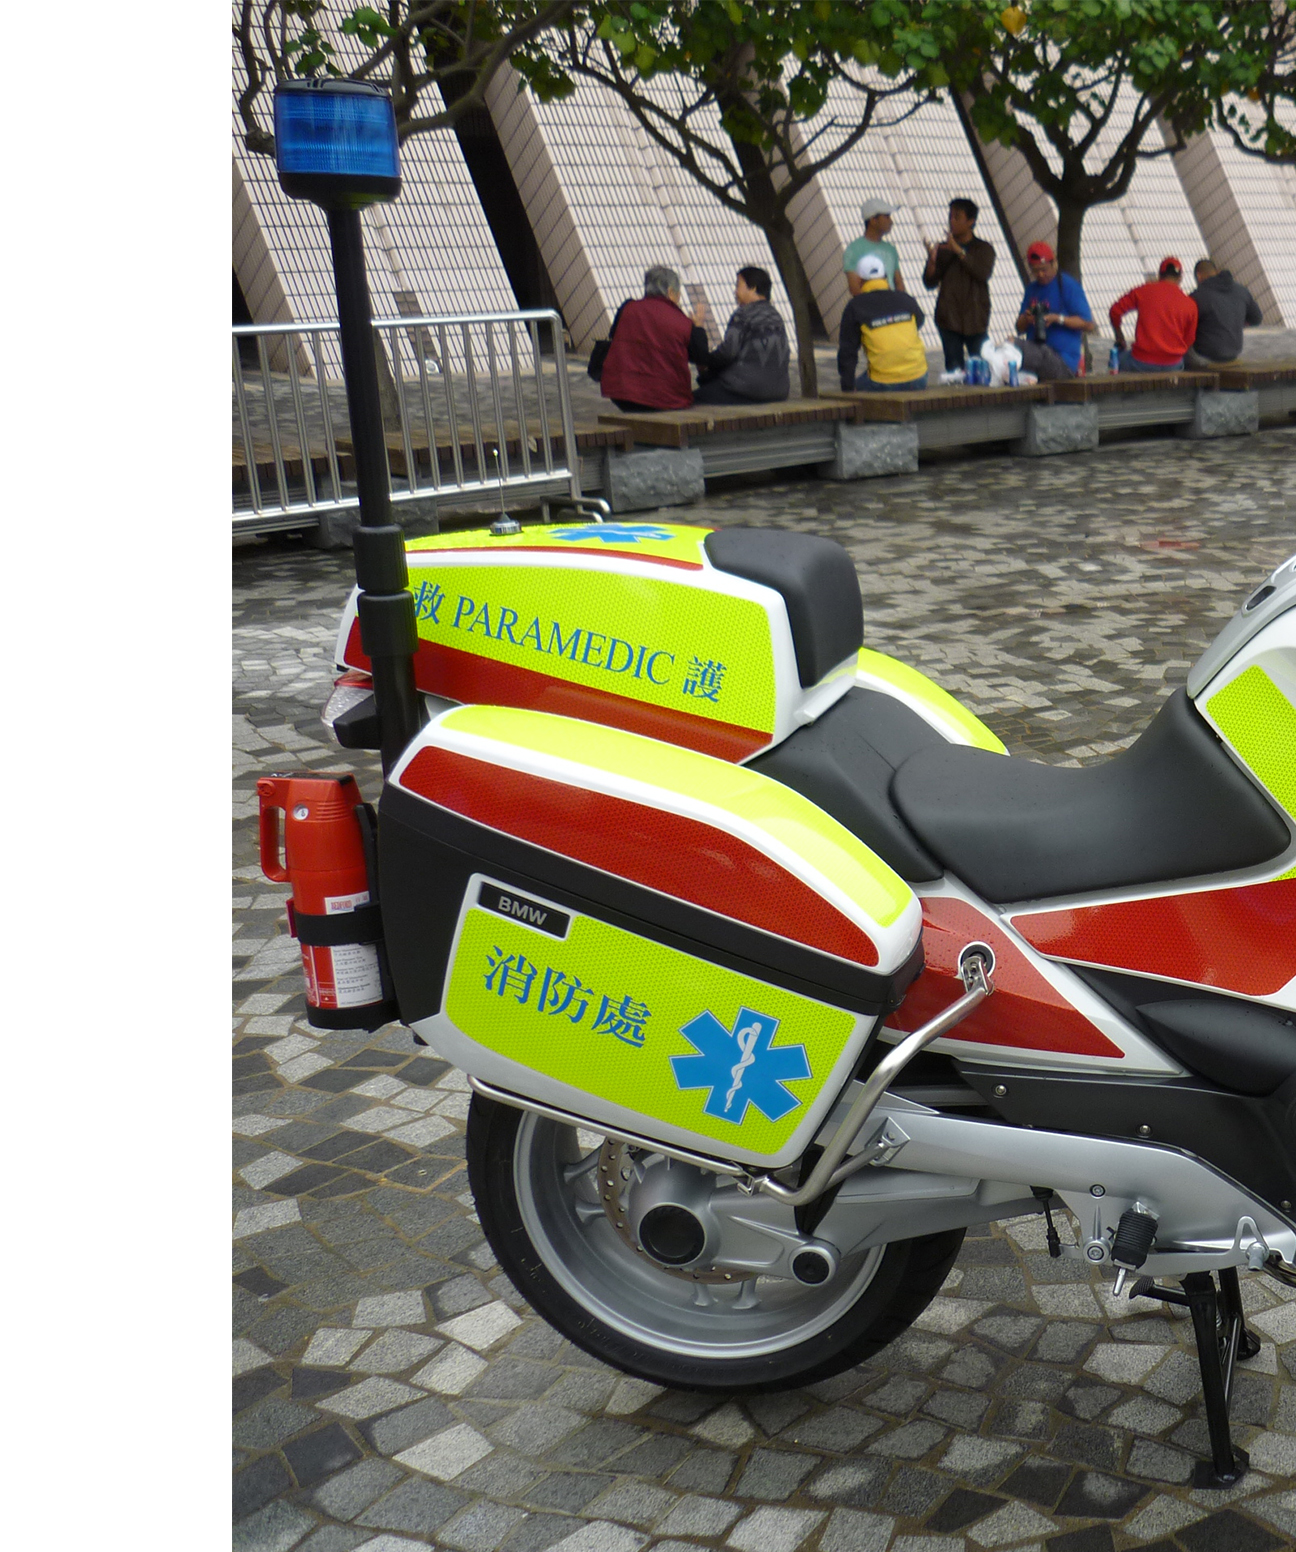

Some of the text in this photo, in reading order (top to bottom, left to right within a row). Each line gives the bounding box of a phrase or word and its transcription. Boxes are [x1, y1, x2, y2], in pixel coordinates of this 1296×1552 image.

[412, 580, 728, 703] 救 PARAMEDIC 護
[498, 895, 548, 926] BMW
[483, 944, 652, 1049] 消防處
